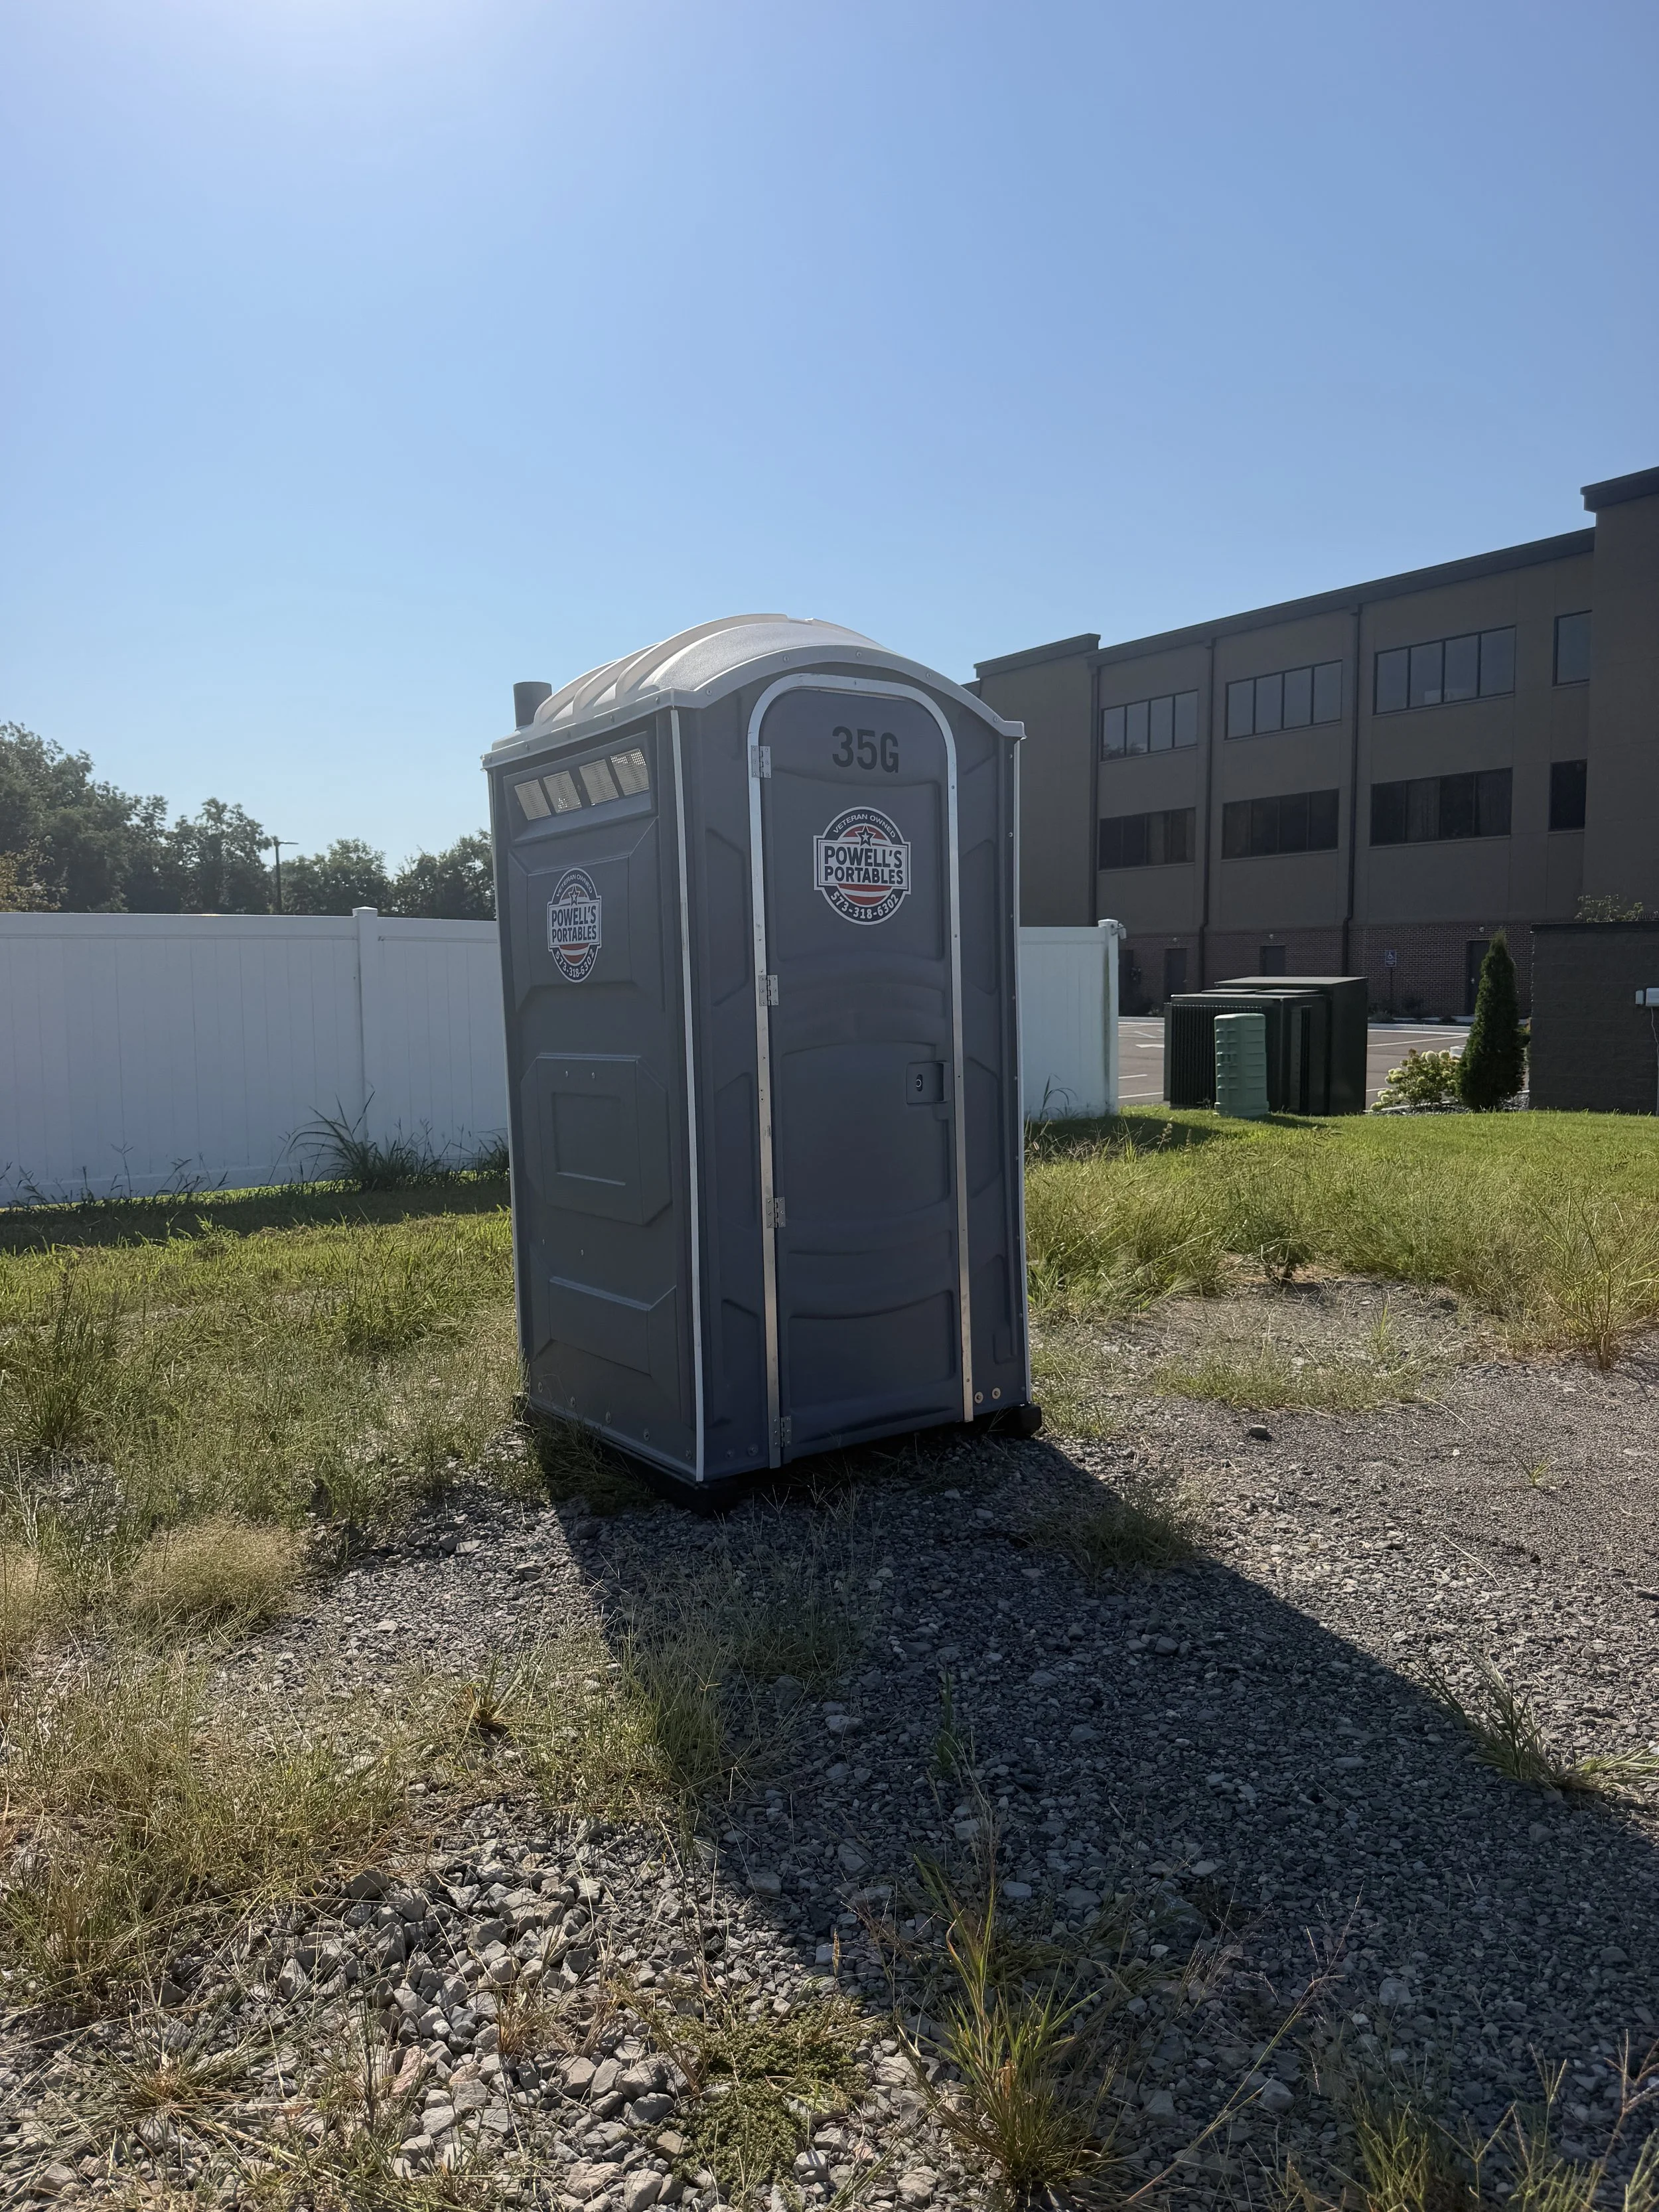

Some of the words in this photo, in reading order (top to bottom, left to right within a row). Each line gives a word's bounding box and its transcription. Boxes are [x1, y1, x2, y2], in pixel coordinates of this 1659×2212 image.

[832, 726, 899, 773] 35G
[833, 814, 868, 834] VETERAN
[869, 815, 895, 838] OWNED
[824, 846, 902, 868] POWELL'S
[556, 874, 576, 897] VETERAN
[576, 874, 593, 894] OWNED
[824, 865, 903, 885] PORTABLES
[551, 905, 597, 927] POWELL'S
[830, 891, 899, 919] 573-318-6302
[552, 925, 597, 943] PORTABLES
[555, 948, 595, 978] 573-318-6302
